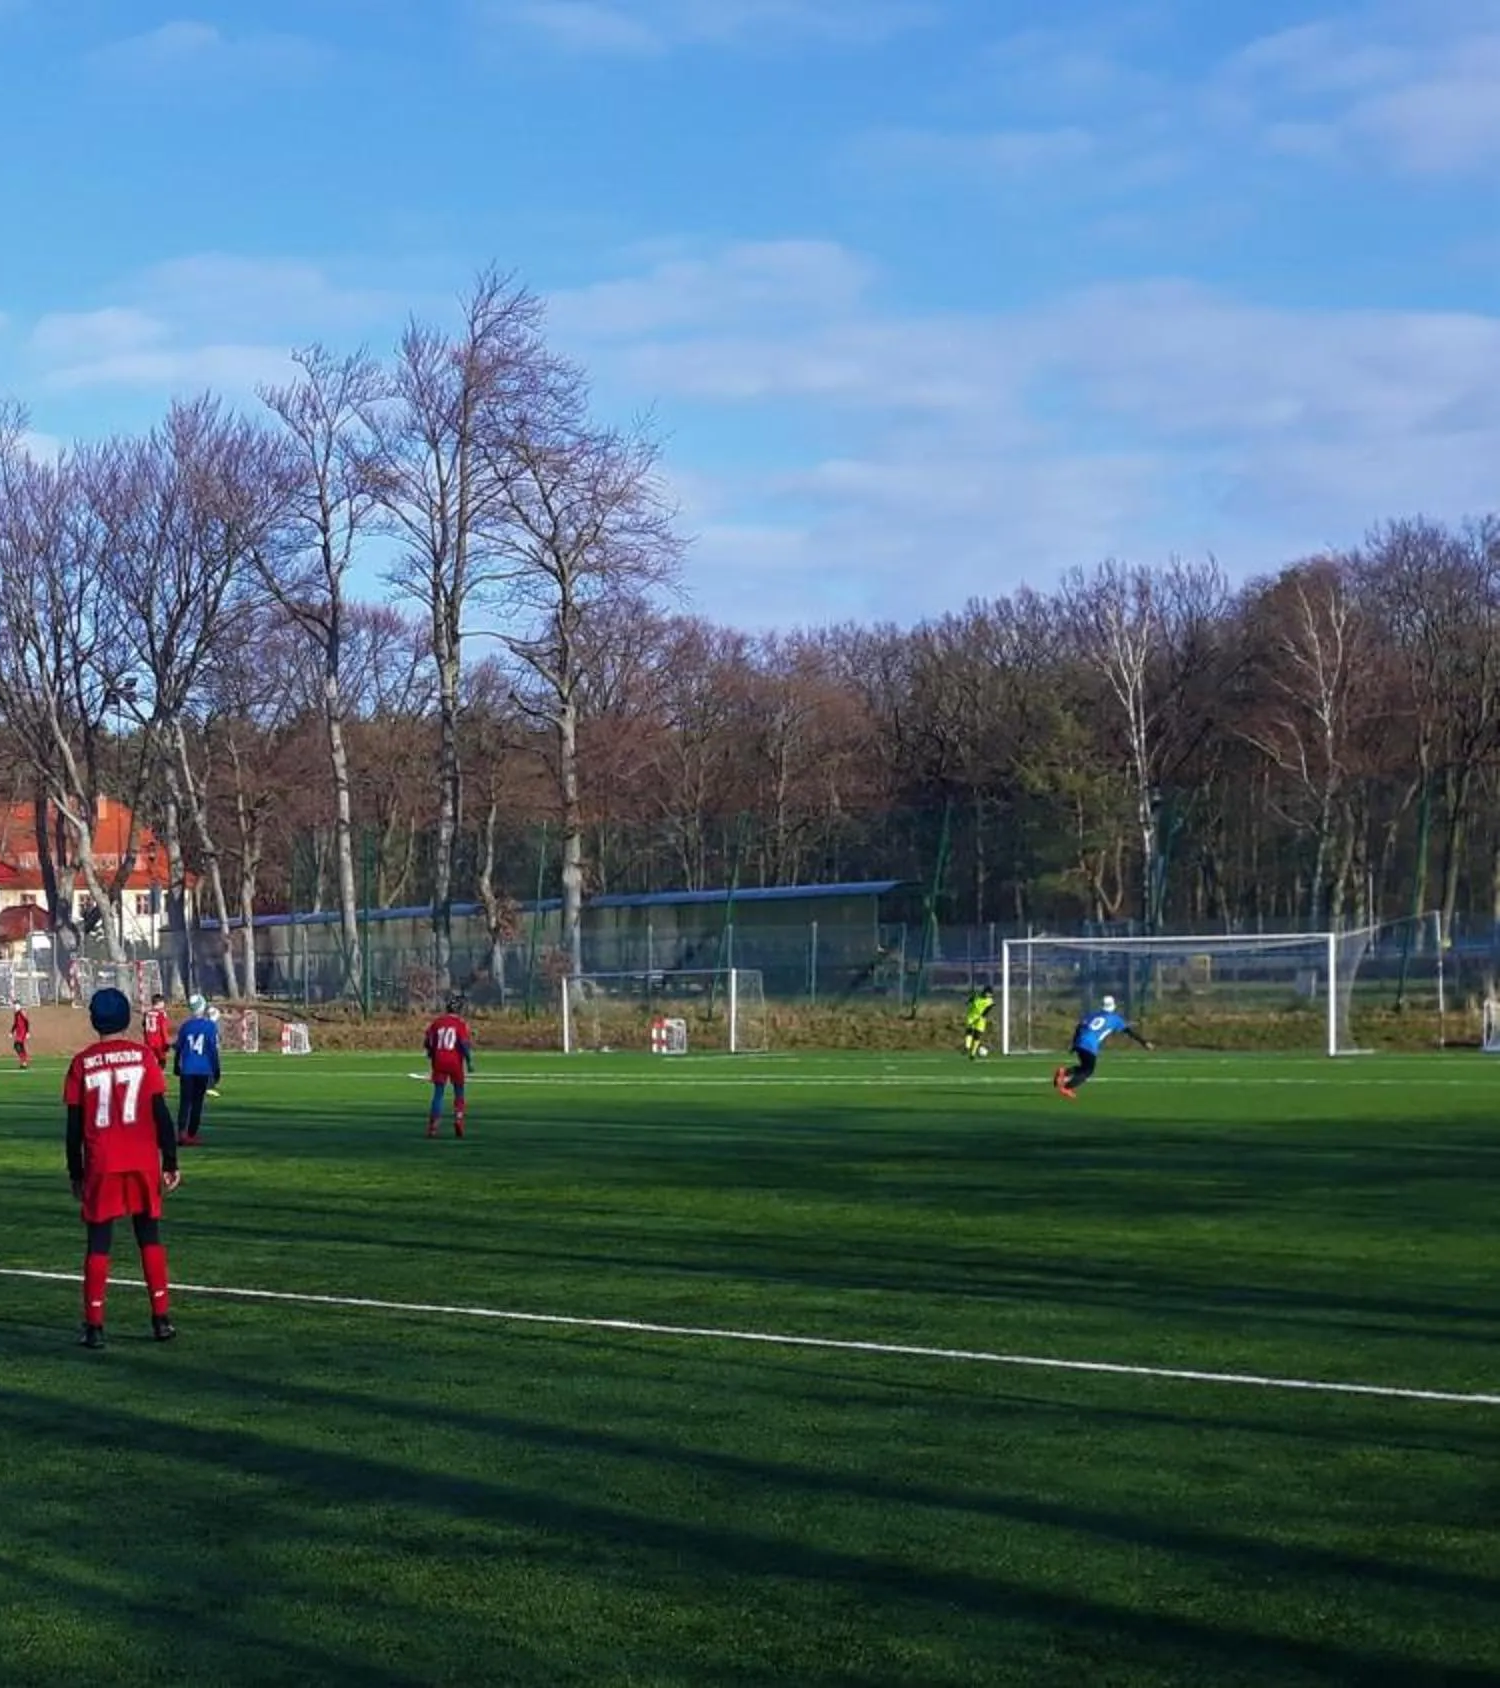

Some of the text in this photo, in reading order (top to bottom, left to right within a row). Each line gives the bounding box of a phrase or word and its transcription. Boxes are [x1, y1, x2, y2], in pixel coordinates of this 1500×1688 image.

[187, 1033, 204, 1055] 14
[437, 1026, 456, 1050] 10
[85, 1066, 145, 1127] 77
